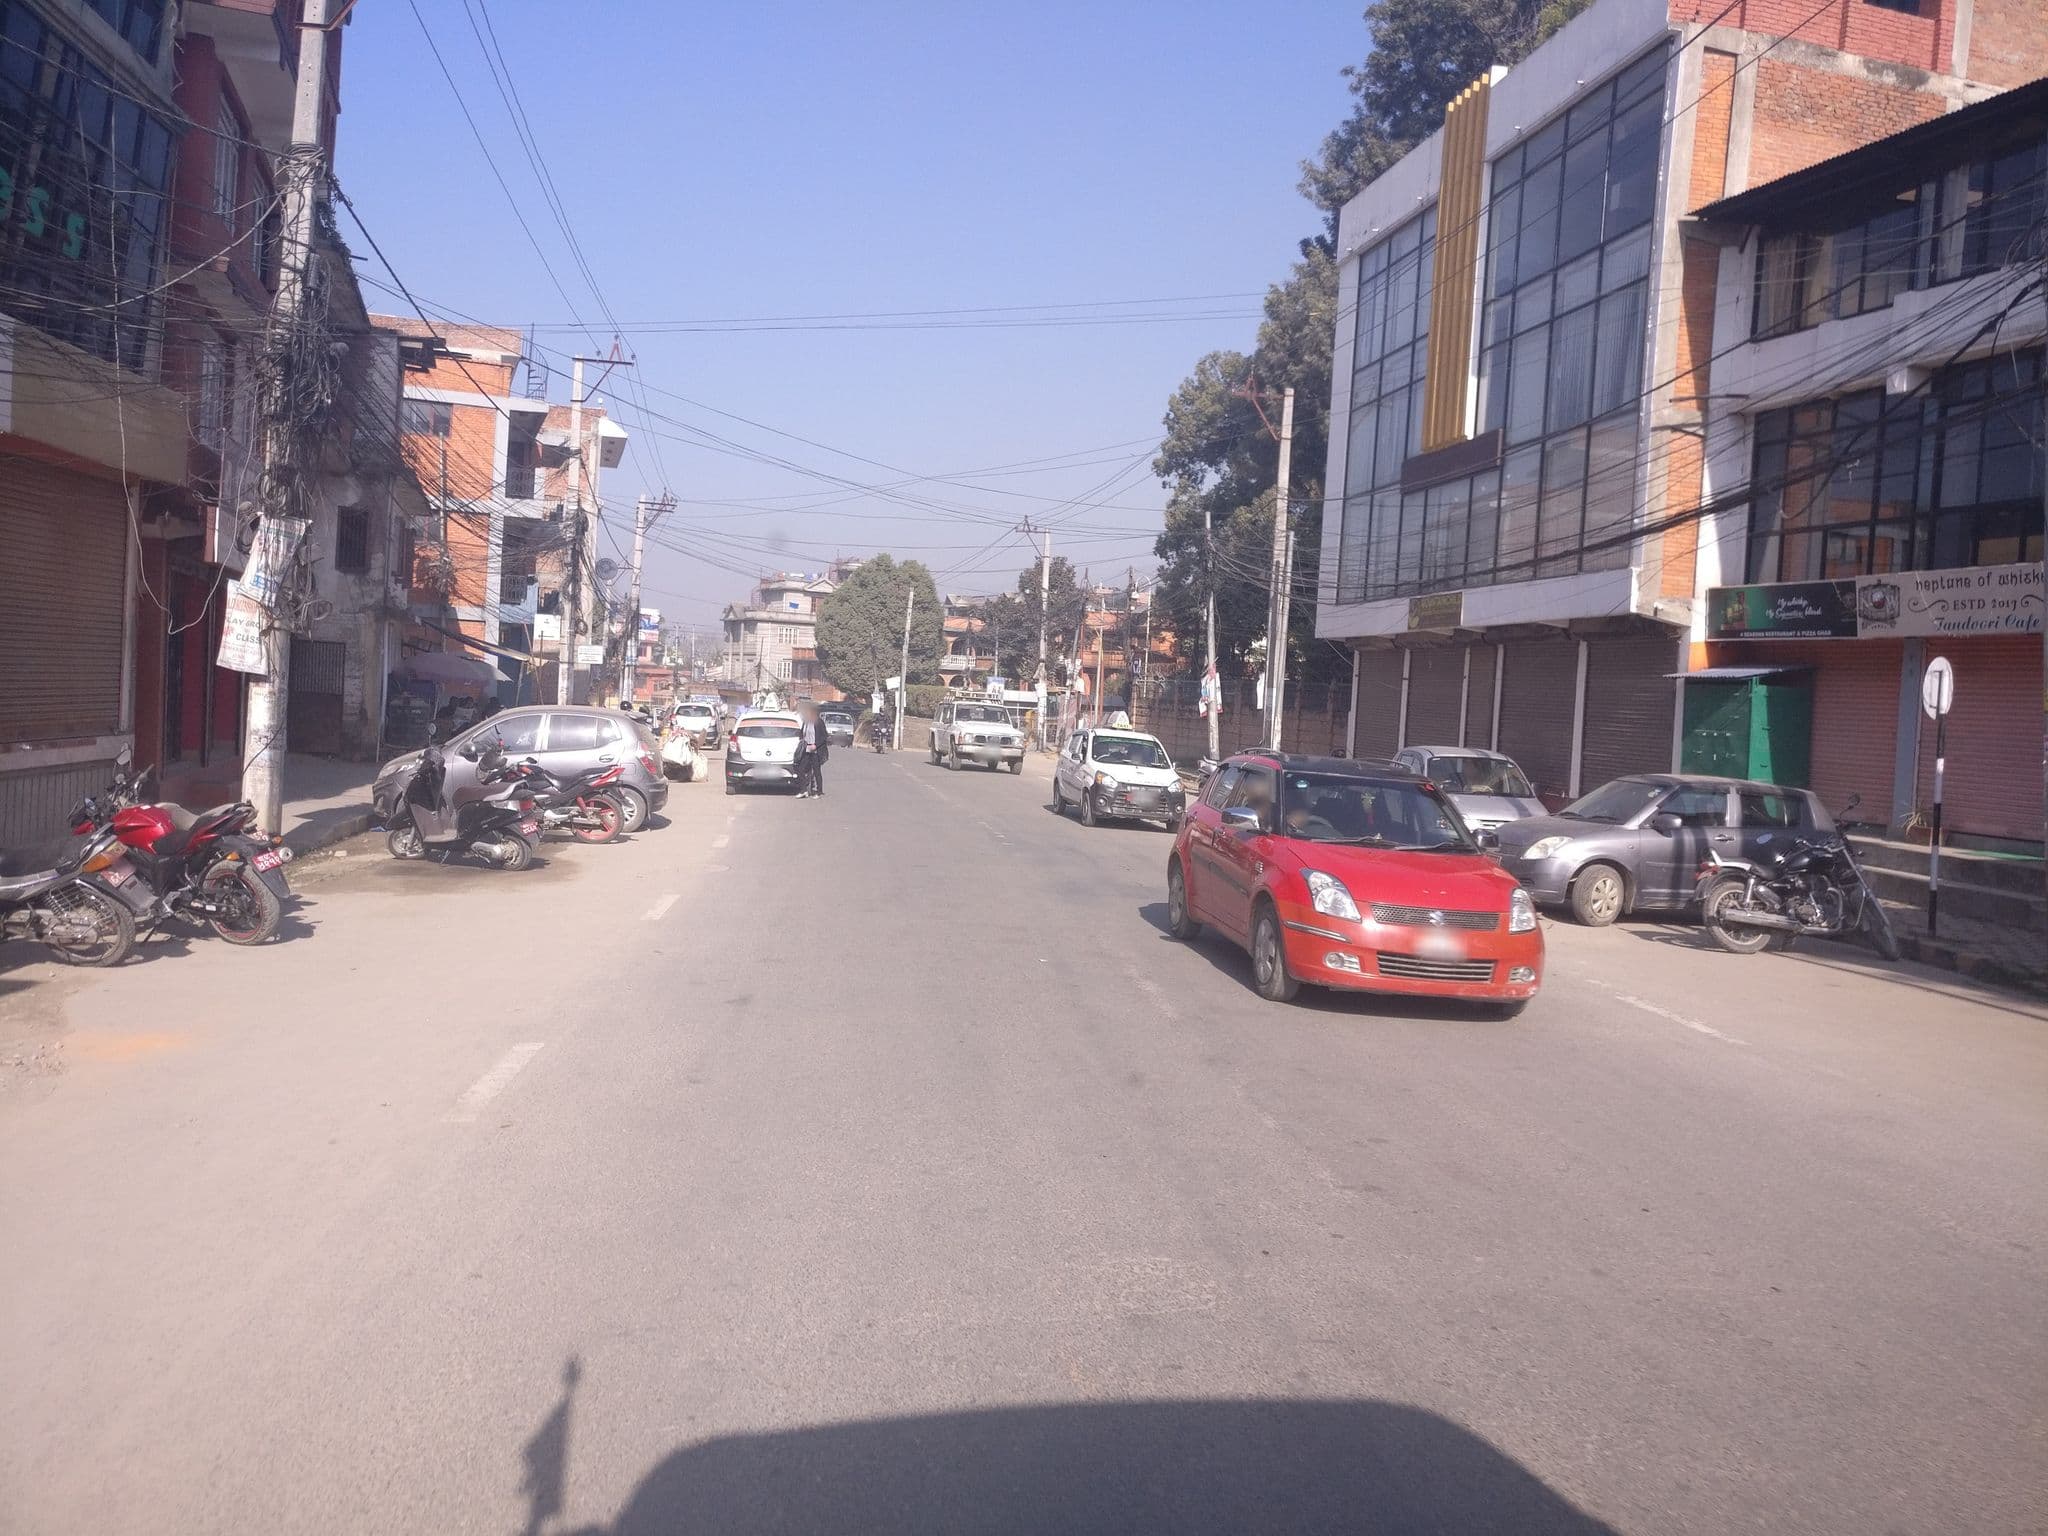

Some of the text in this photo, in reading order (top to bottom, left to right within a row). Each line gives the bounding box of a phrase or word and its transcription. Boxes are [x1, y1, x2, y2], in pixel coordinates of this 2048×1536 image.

[1977, 571, 1993, 587] of
[1953, 599, 2018, 612] ESTD 2017
[1934, 614, 2041, 632] Tandoori Cafe
